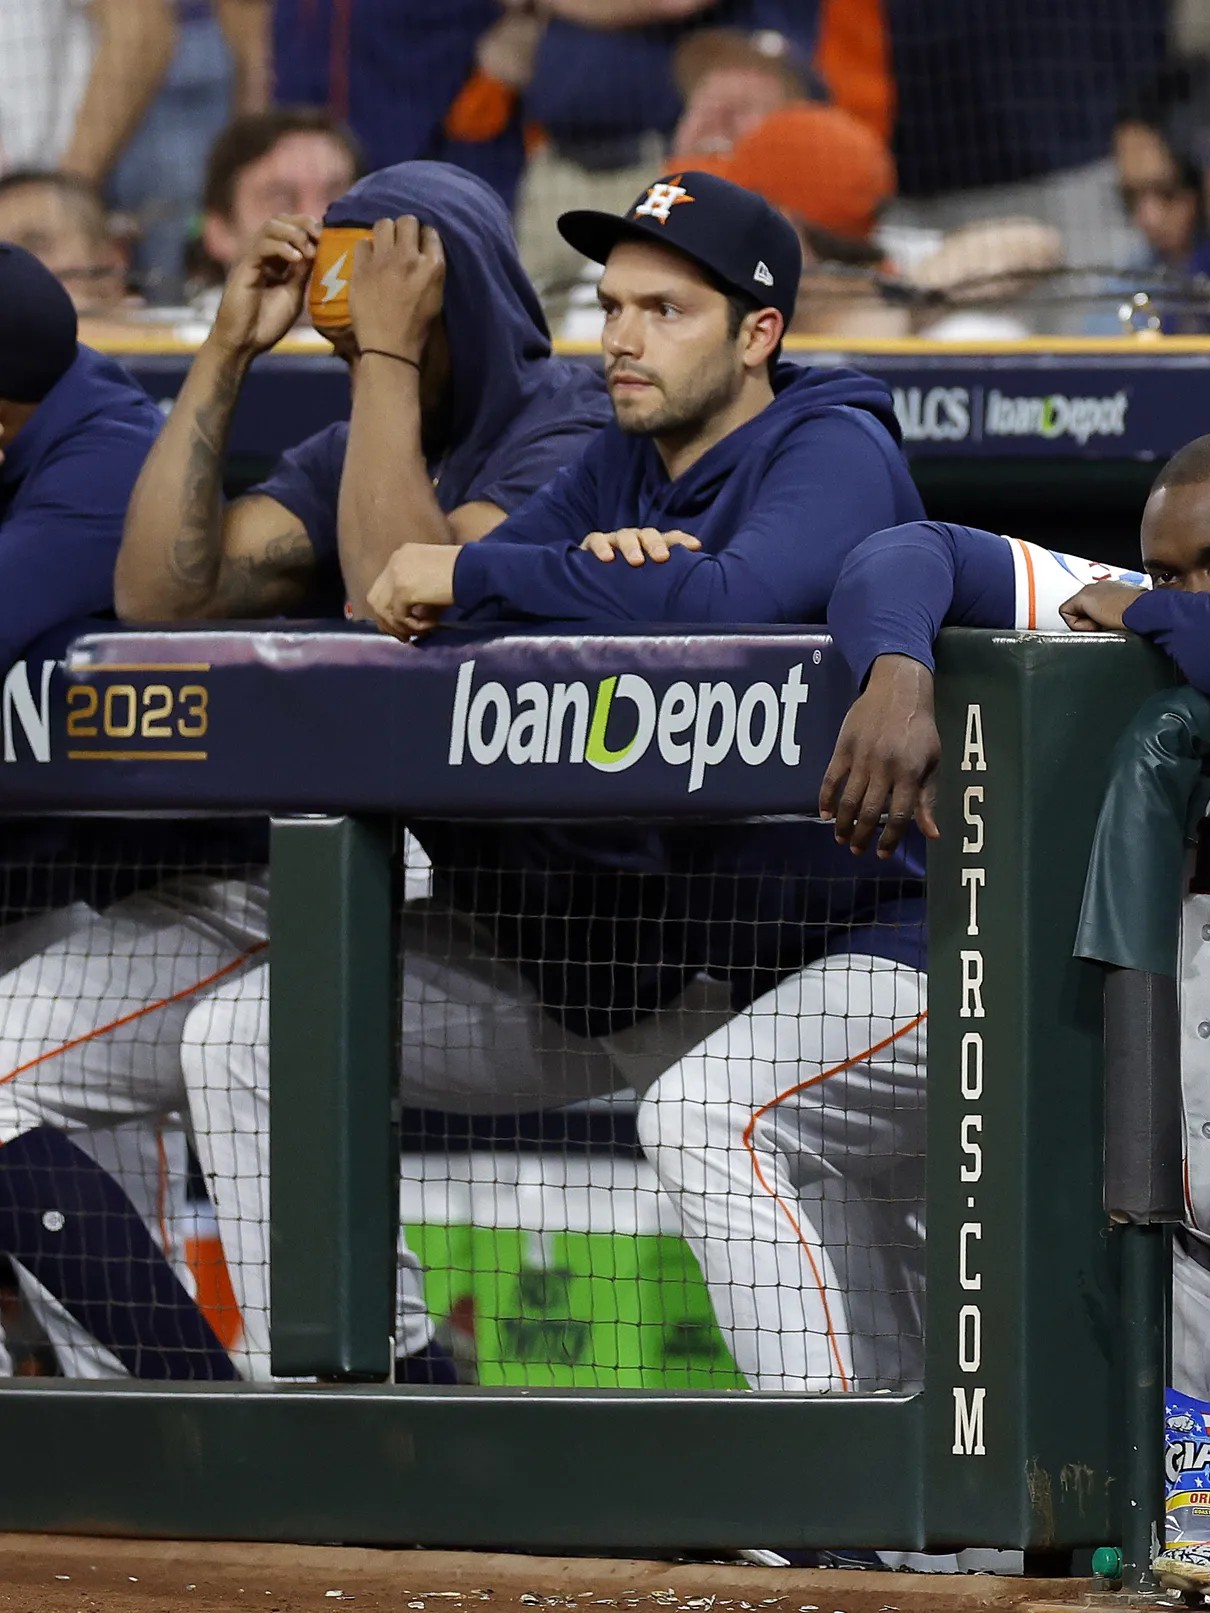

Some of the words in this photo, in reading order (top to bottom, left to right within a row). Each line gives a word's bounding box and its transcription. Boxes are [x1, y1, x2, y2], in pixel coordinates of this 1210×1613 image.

[985, 388, 1128, 446] loanDepot
[66, 684, 209, 738] 2023
[448, 659, 809, 793] loanDepot
